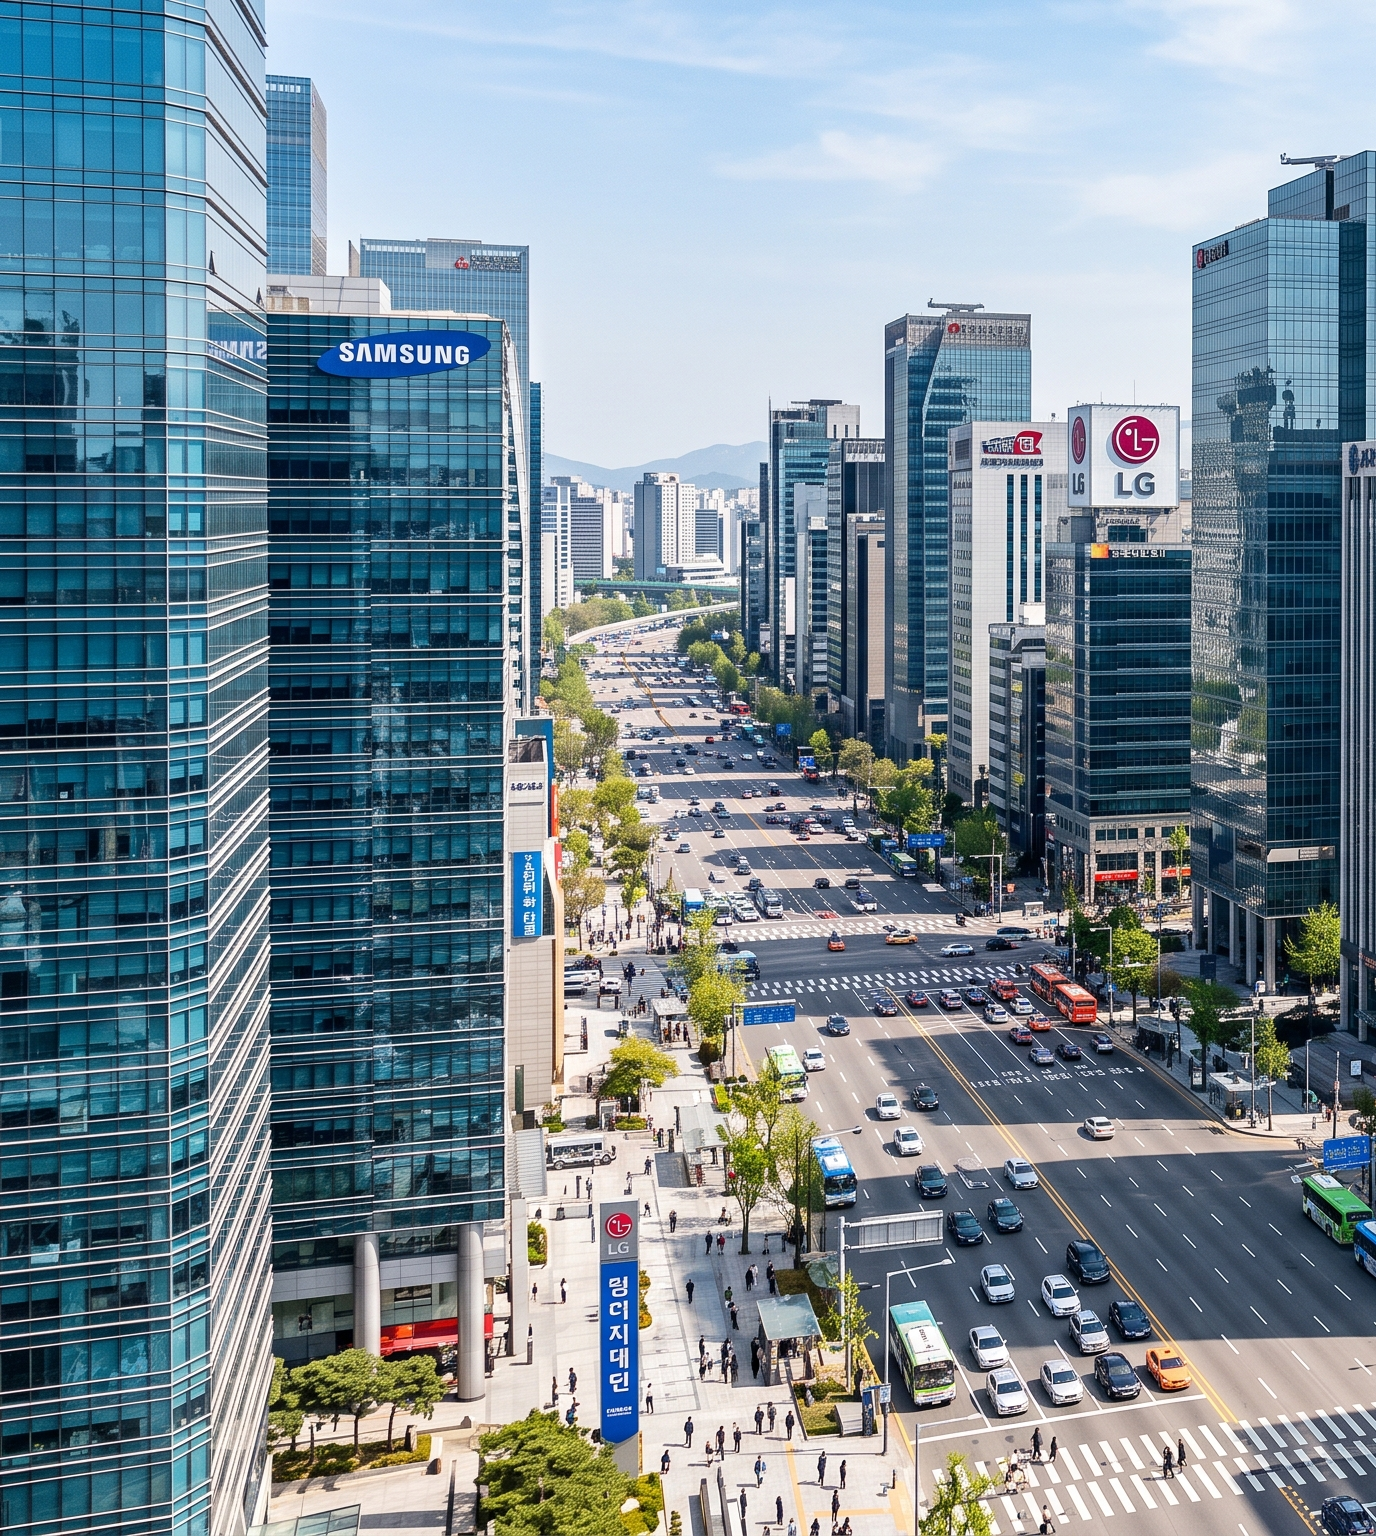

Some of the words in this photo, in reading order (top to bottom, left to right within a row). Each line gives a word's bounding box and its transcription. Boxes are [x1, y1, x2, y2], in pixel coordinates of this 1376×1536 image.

[338, 342, 471, 365] SAMSUNG
[1072, 472, 1085, 495] LG
[1117, 472, 1155, 496] LG
[608, 1241, 629, 1255] LG
